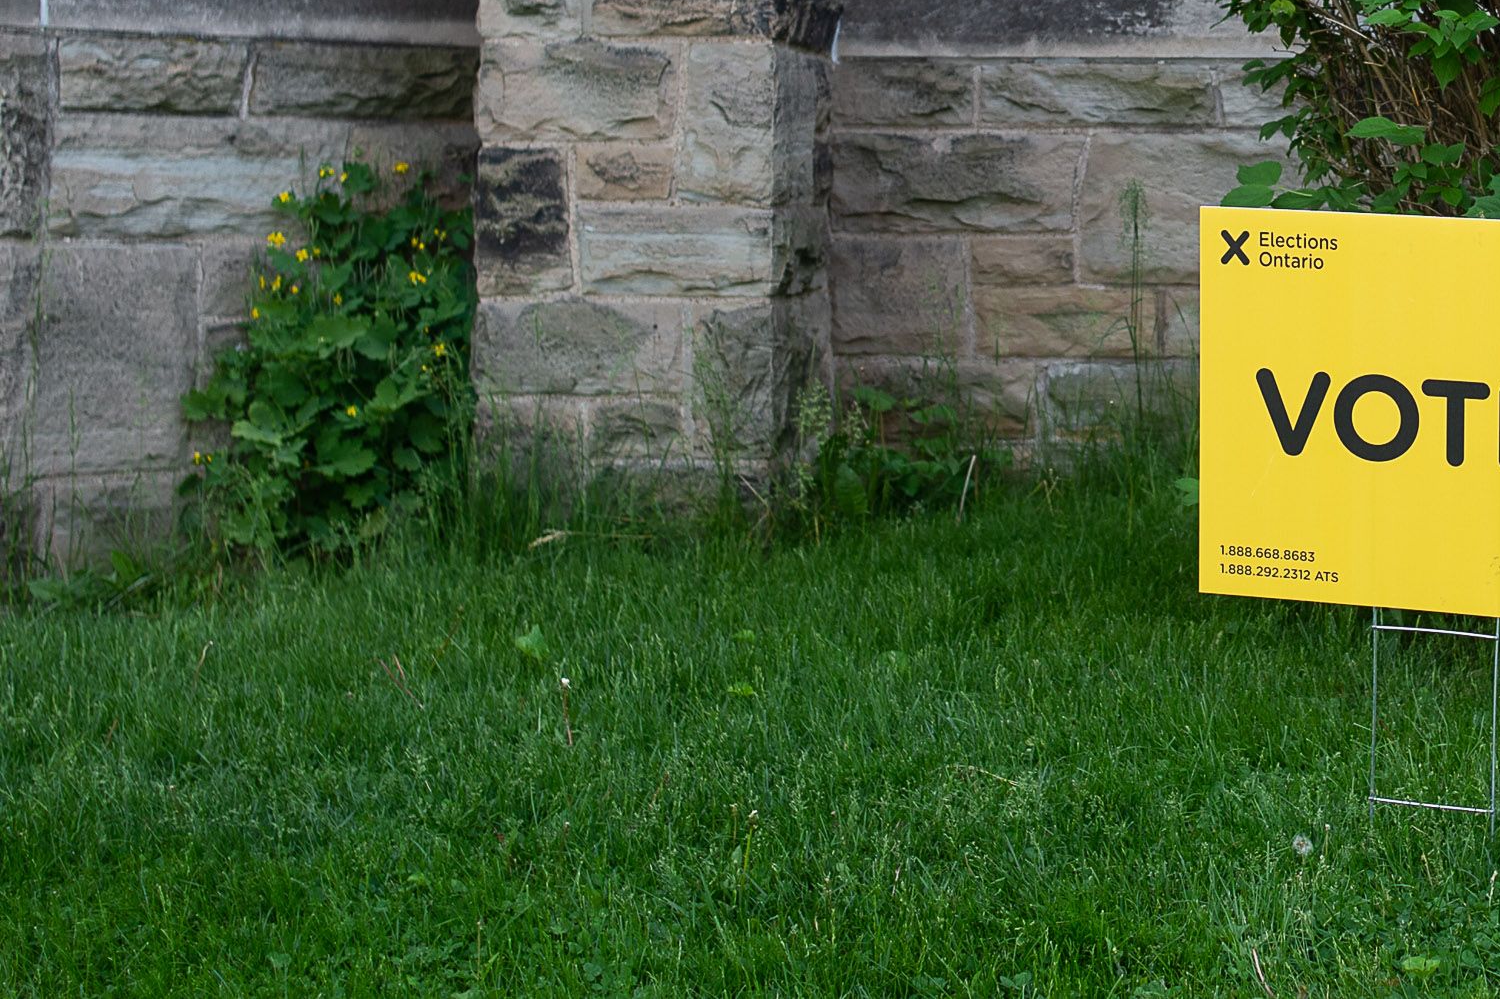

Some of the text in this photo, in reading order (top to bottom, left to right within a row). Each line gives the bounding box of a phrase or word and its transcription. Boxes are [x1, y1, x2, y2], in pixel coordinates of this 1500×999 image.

[1259, 231, 1338, 251] Elections
[1259, 251, 1324, 270] Ontario
[1219, 544, 1316, 563] 1.888.668.8683
[1219, 563, 1339, 583] 1.888.292.2312 ATS
